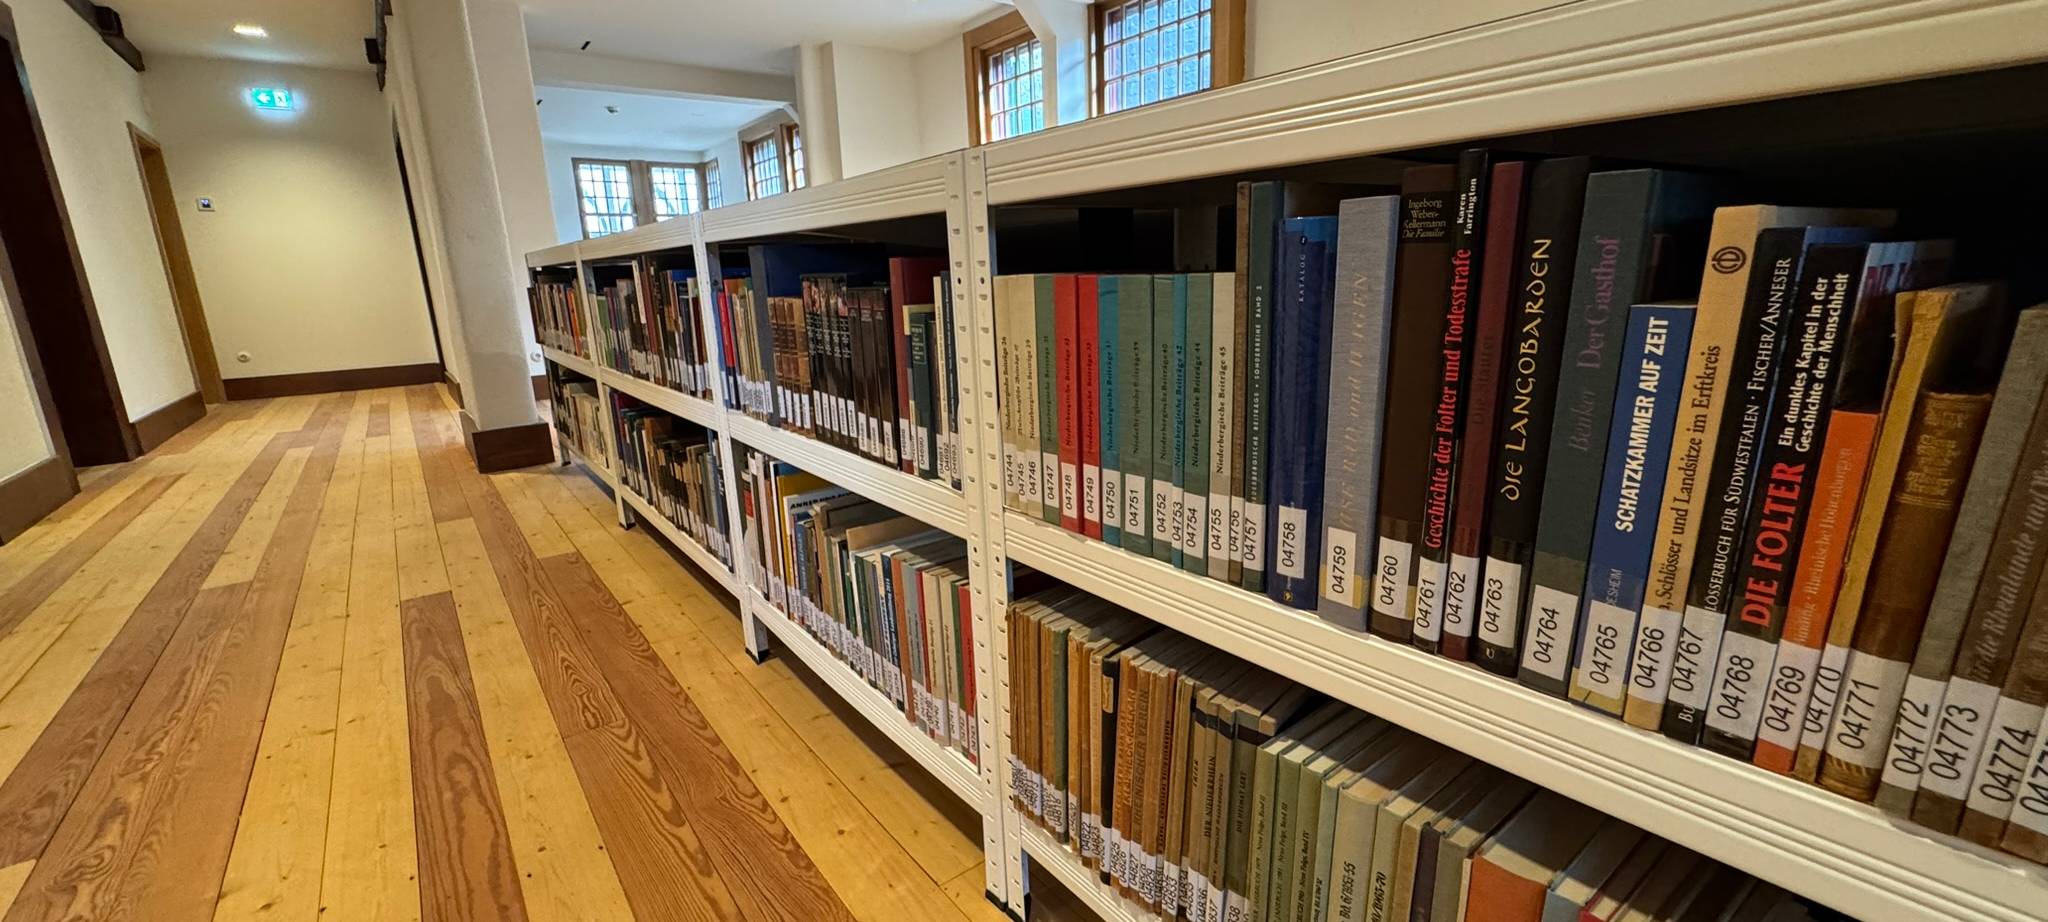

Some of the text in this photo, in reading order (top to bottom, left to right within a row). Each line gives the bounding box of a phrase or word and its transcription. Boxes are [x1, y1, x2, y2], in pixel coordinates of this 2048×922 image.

[1408, 198, 1442, 209] Ingeborg
[1411, 210, 1440, 219] Weber-
[1456, 193, 1467, 224] Karen
[1463, 178, 1478, 235] Farrington
[1299, 254, 1307, 302] KATALOG
[1505, 238, 1553, 452] LANGOBARDEN
[1569, 235, 1619, 451] Benker Der Gasthof
[1778, 277, 1829, 447] Ein dunkles Kapitel in der
[1795, 273, 1850, 453] Geschichte der Menschheit
[1175, 359, 1184, 395] Beiträge
[1192, 355, 1202, 393] Beiträge
[1424, 249, 1472, 549] Geschichte der Folter und Todesstrafe
[1174, 397, 1182, 467] Niederbergische
[1191, 396, 1202, 468] Niederbergische
[1216, 346, 1227, 474] Niederbergische Beiträge 45
[1615, 316, 1670, 533] SCHATZKAMMER AUF ZEIT
[1704, 257, 1792, 612] LÖSSERBUCH FÜR SÜDWESTFALEN FISCHER/ANNESER
[1006, 454, 1014, 488] 04744
[1017, 463, 1026, 496] 04745
[1028, 461, 1037, 495] 04746
[1046, 465, 1056, 500] 04747
[1064, 475, 1074, 510] 04748
[1086, 477, 1095, 514] 04749
[1655, 344, 1721, 605] Schlösser und Landsitze im Erftkreis
[1105, 481, 1116, 519] 04750
[1128, 489, 1139, 527] 04751
[1156, 493, 1167, 533] 04752
[1172, 501, 1183, 542] 04753
[1186, 507, 1198, 548] 04754
[1211, 508, 1222, 550] 04755
[1230, 510, 1240, 552] 04756
[1243, 519, 1257, 561] 04757
[1281, 522, 1296, 568] 04758
[1740, 462, 1806, 628] DIE FOLTER
[1332, 545, 1346, 594] 04759
[1380, 555, 1398, 605] 04760
[1981, 532, 2037, 637] Rheinlande
[1416, 579, 1436, 629] 04761
[1446, 571, 1467, 624] 04762
[1483, 579, 1503, 633] 04763
[1533, 606, 1560, 664] 04764
[1589, 624, 1618, 684] 04765
[1634, 626, 1665, 689] 04766
[1672, 627, 1703, 693] 04767
[1716, 654, 1754, 720] 04768
[1764, 665, 1805, 733] 04769
[1803, 666, 1842, 733] 04770
[1837, 679, 1880, 750] 04771
[1891, 697, 1929, 775] 04772
[1133, 689, 1149, 827] RHEINISCHER VEREIN
[1928, 704, 1980, 780] 04773
[1980, 725, 2037, 802] 04774
[1205, 755, 1217, 819] NIEDERRHEIN
[1081, 822, 1091, 851] 04822
[1110, 841, 1120, 873] 04825
[1129, 854, 1139, 886] 04827
[1168, 877, 1177, 910] 04833
